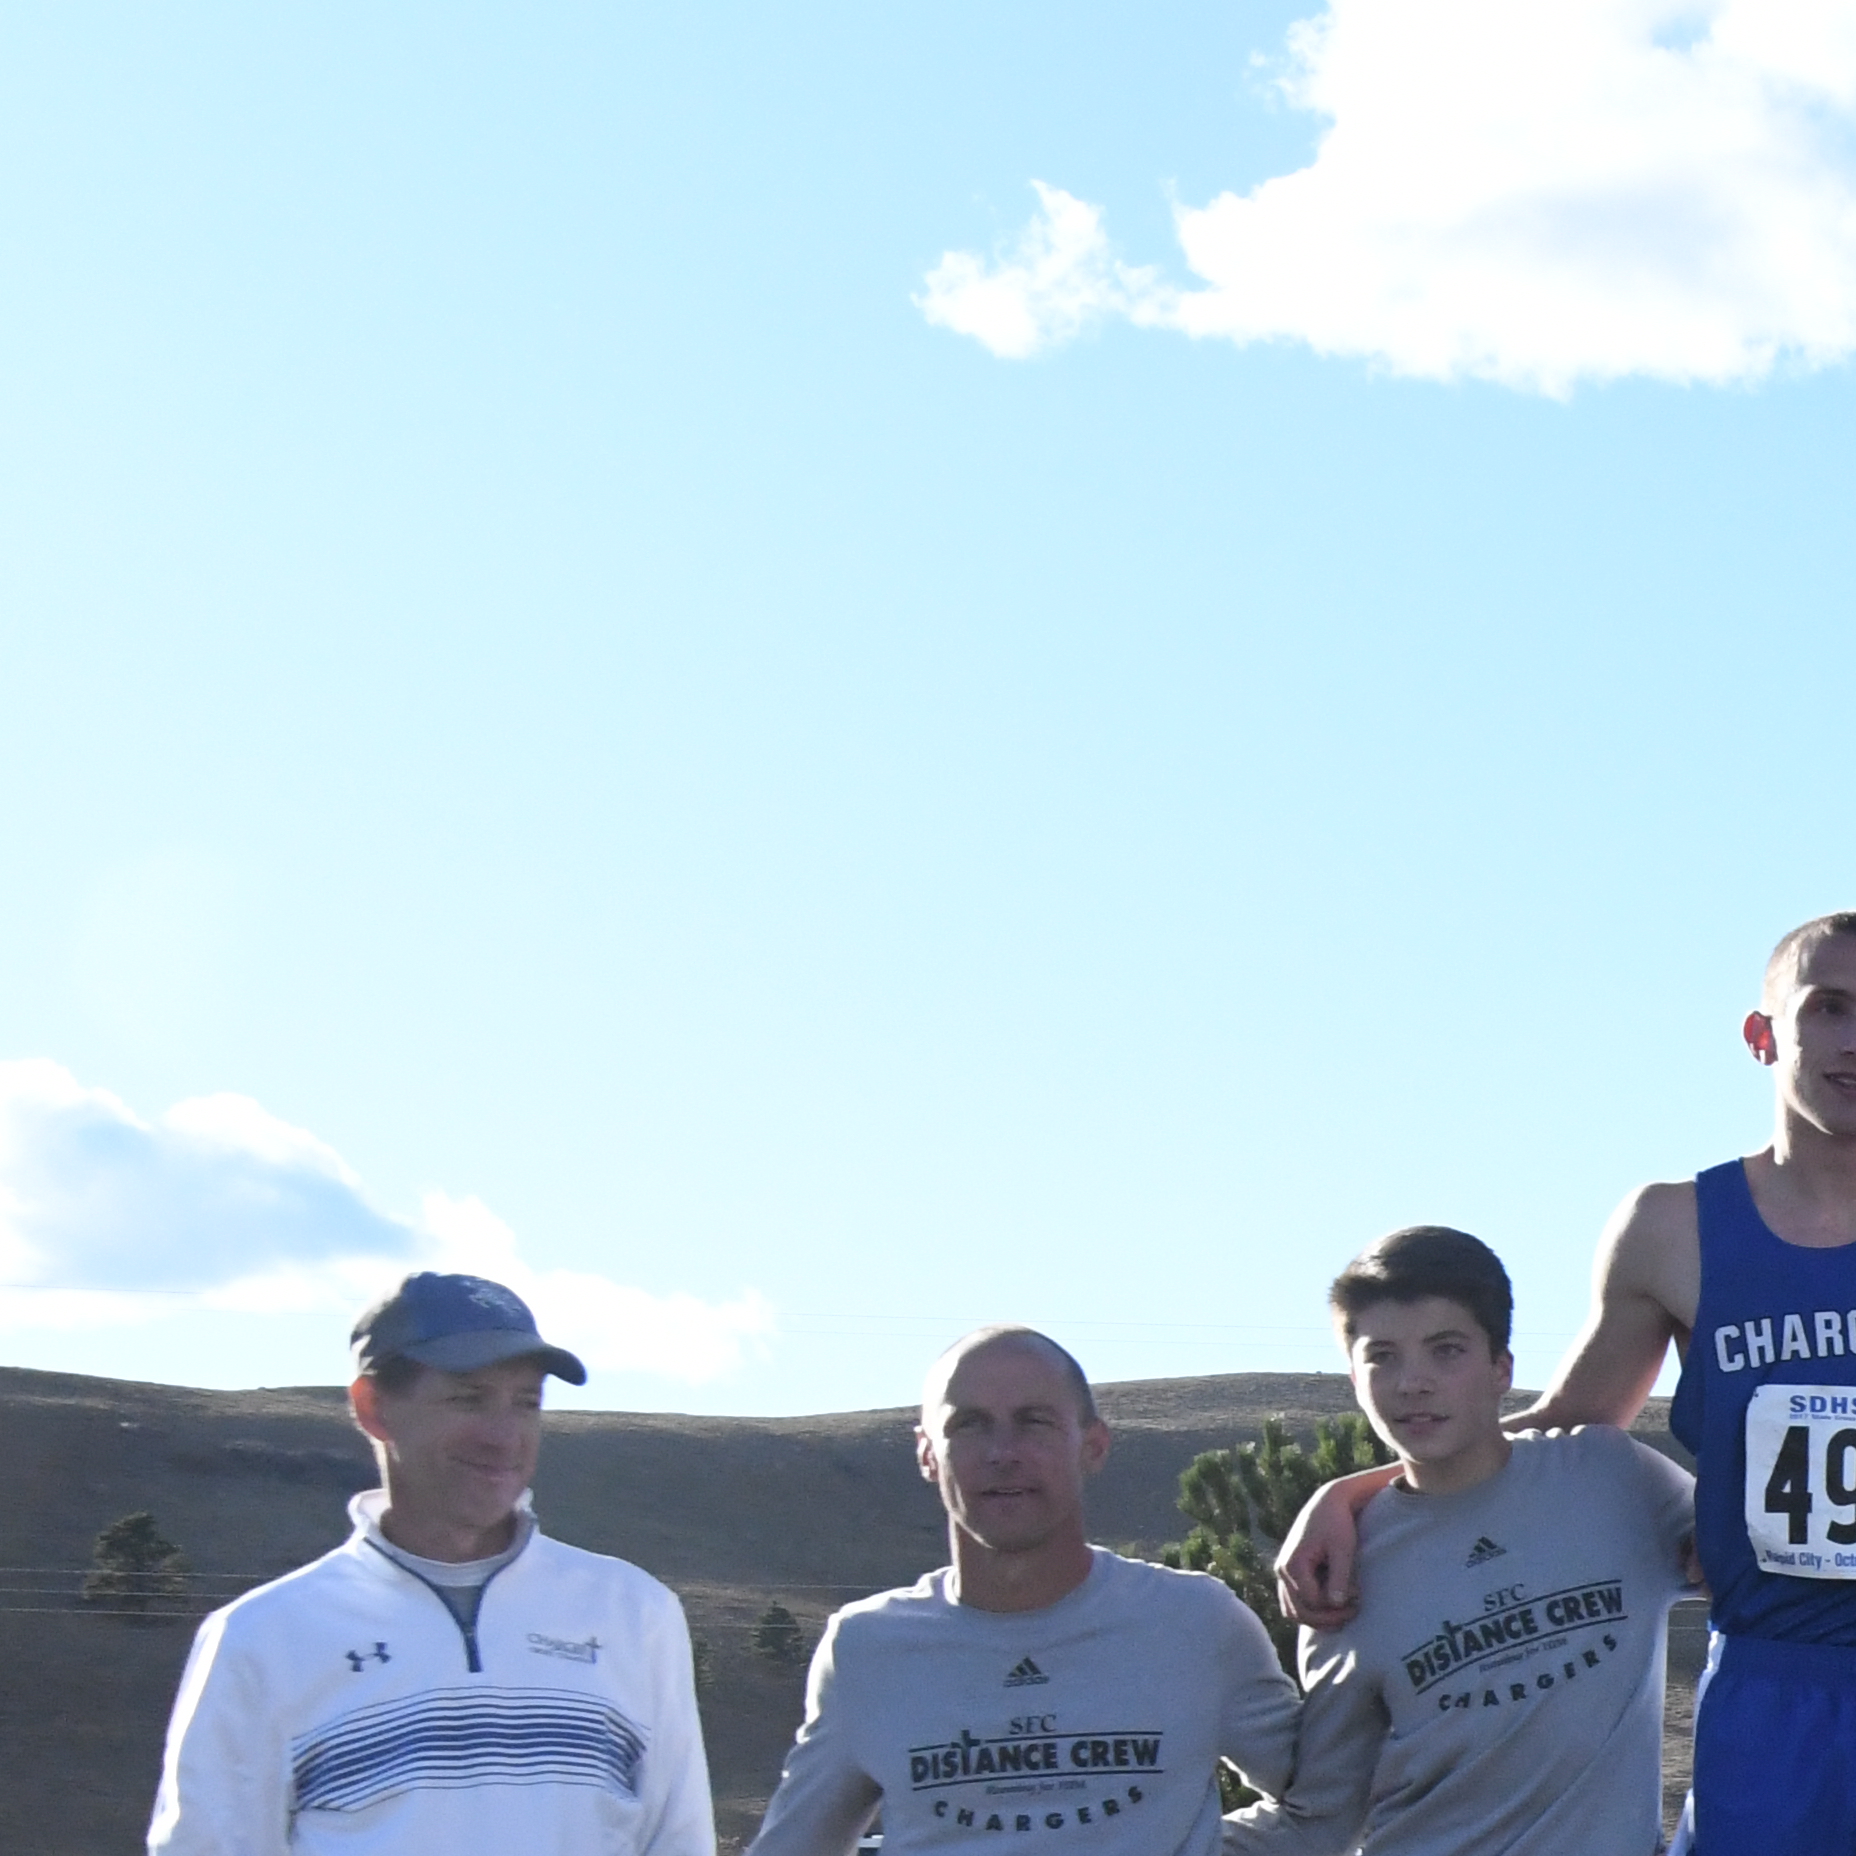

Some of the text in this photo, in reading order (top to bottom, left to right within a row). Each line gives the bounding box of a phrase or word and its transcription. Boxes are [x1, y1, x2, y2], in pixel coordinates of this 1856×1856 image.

[1799, 1552, 1822, 1569] City
[1483, 1583, 1525, 1612] SFC
[1406, 1587, 1623, 1687] DISTANCE CREW
[1438, 1634, 1618, 1711] CHARGERS
[1009, 1714, 1058, 1735] SFC
[910, 1730, 1161, 1784] DISTANCE CREW
[934, 1786, 1143, 1832] CHARGERS
